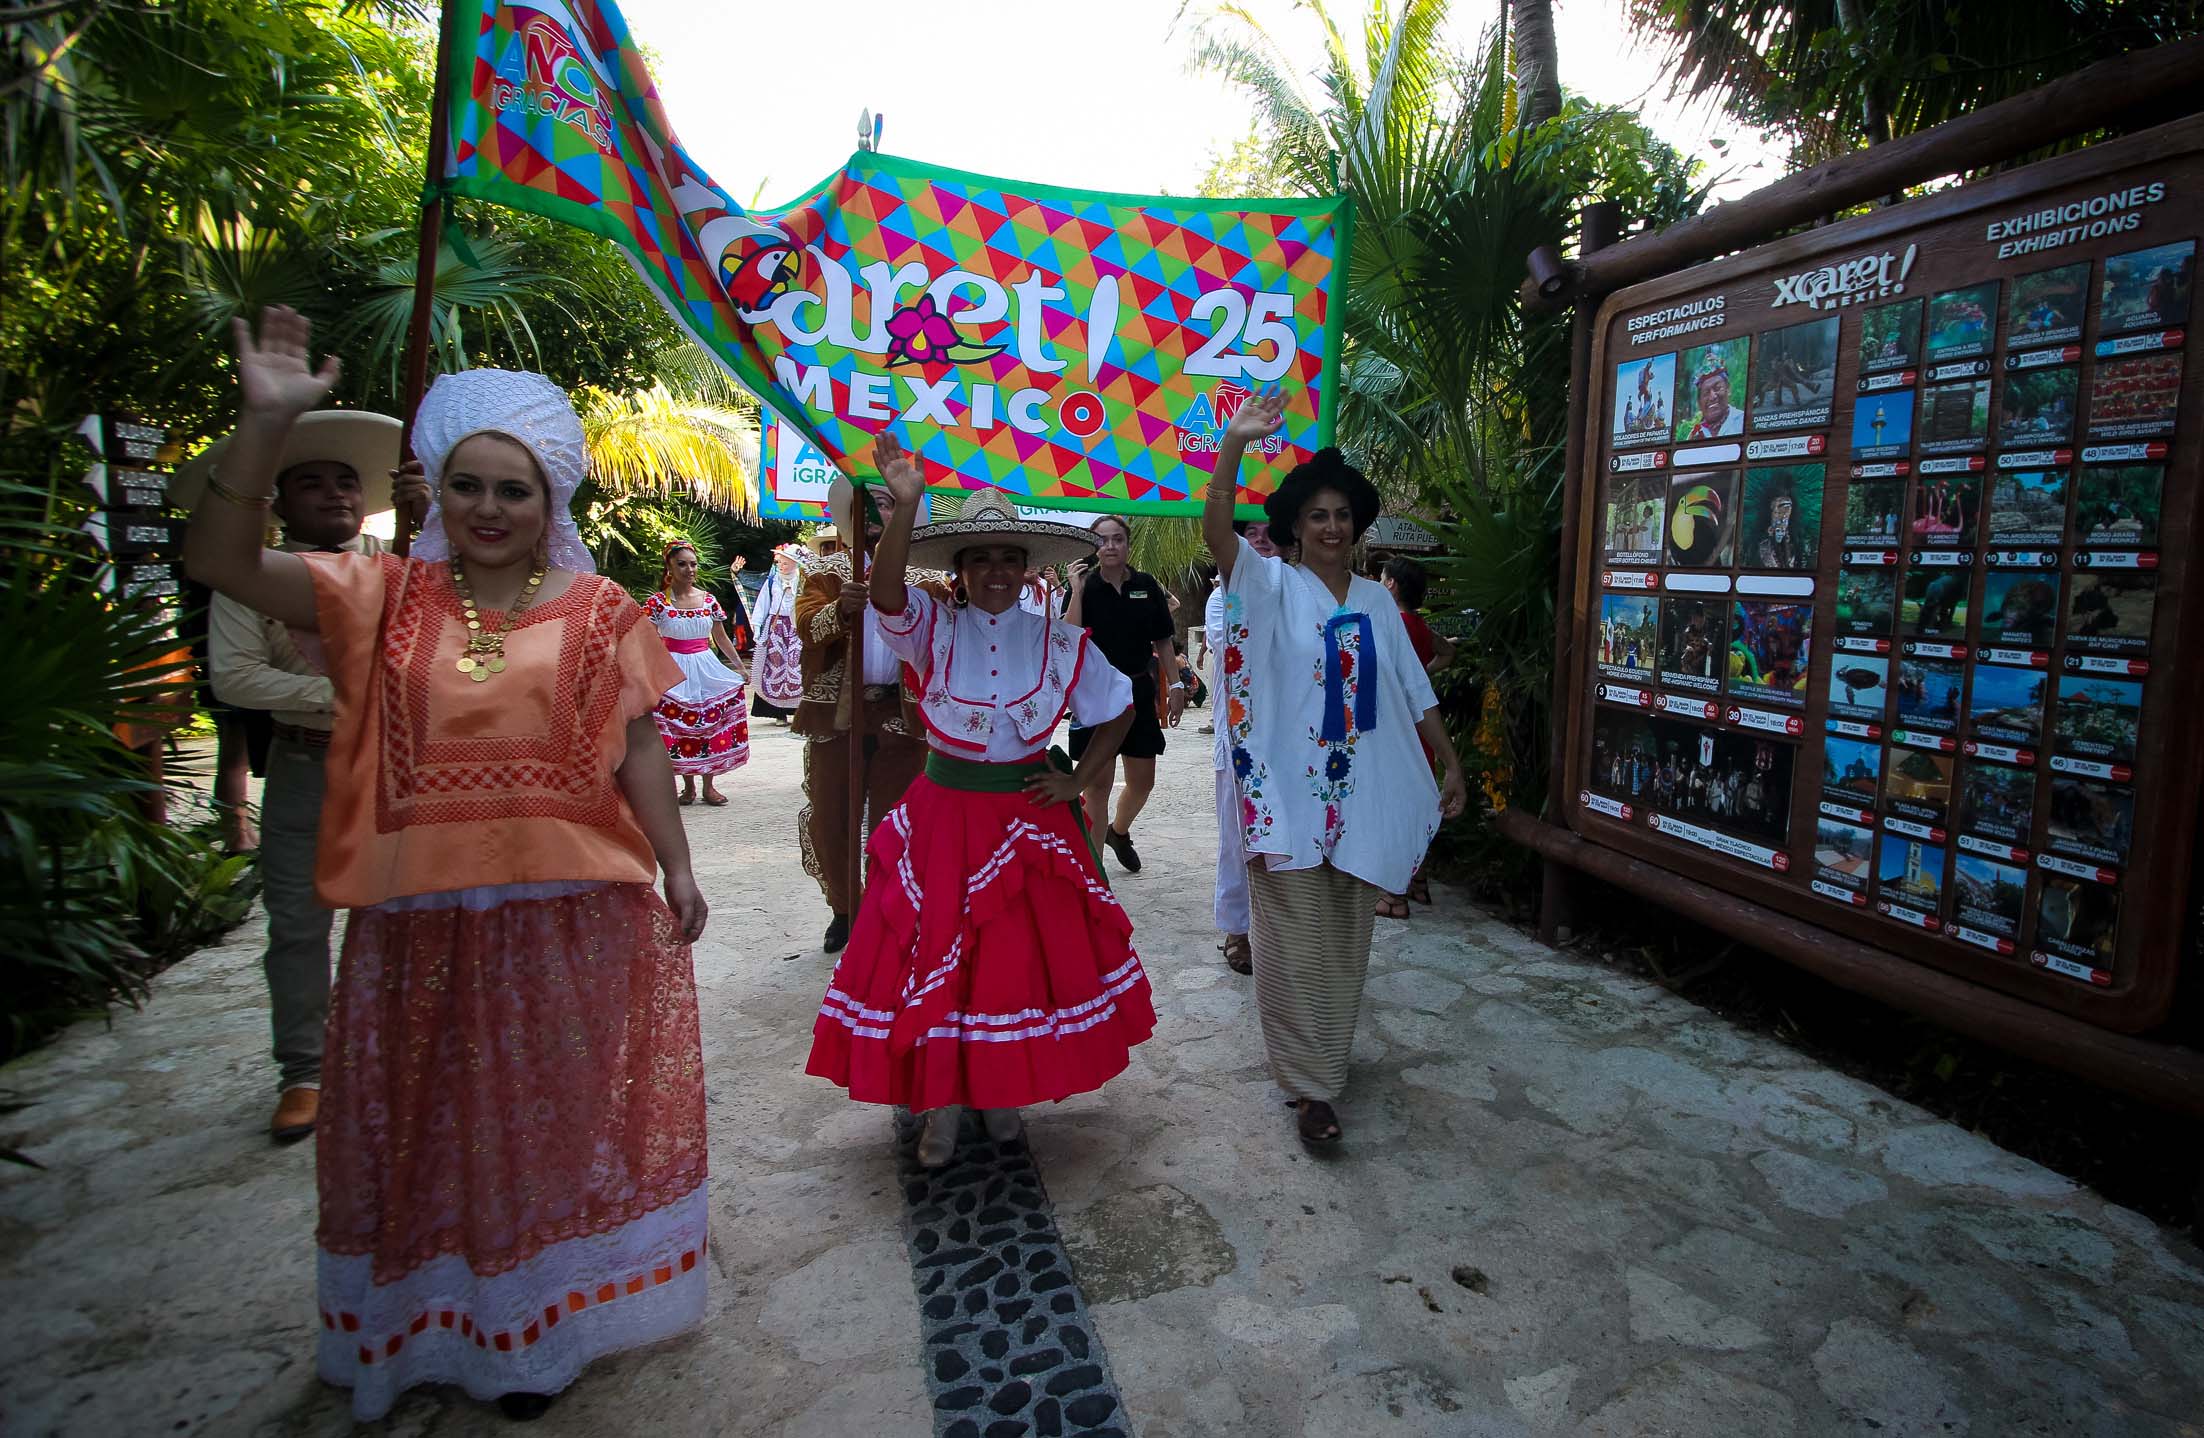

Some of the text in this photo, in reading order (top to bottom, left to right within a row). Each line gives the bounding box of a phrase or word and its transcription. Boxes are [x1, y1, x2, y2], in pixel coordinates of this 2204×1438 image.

[496, 21, 614, 131] AÑOS
[489, 84, 612, 154] ¡GRACIAS!
[1986, 182, 2167, 241] EXHIBICIONES
[1998, 212, 2142, 259] EXHIBITIONS
[1825, 283, 1905, 310] MEXICO
[1627, 296, 1725, 331] ESPECTACULOS
[2126, 312, 2158, 321] ACUARIO
[1632, 313, 1725, 345] PERFORMANCES
[1182, 287, 1298, 382] 25
[774, 355, 1106, 438] MEXICO
[1181, 384, 1283, 430] AÑ
[1754, 415, 1778, 423] DANZAS
[1799, 415, 1826, 424] DANCES
[1177, 433, 1283, 453] ¡GRAIAS!
[1748, 445, 1758, 454] 51
[2085, 449, 2096, 458] 48
[1612, 459, 1618, 468] 9
[2000, 456, 2011, 464] 50
[1922, 463, 1931, 471] 51
[1393, 532, 1415, 541] RUTA
[1960, 554, 1969, 562] 13
[1987, 554, 1997, 562] 10
[2042, 554, 2052, 563] 16
[2077, 554, 2088, 563] 11
[1836, 638, 1844, 646] 12
[1905, 643, 1914, 652] 15
[1978, 650, 1989, 659] 19
[2068, 657, 2080, 666] 21
[1599, 687, 1604, 696] 3
[1656, 696, 1666, 706] 60
[1728, 710, 1740, 720] 39
[2052, 758, 2064, 767] 46
[1581, 793, 1589, 802] 60
[1650, 815, 1659, 825] 60
[1716, 836, 1729, 844] GRAN
[1960, 836, 1970, 846] 51
[1698, 836, 1771, 864] XCARET ESPECTACULAR
[1776, 855, 1786, 863] 120
[2039, 856, 2050, 865] 52
